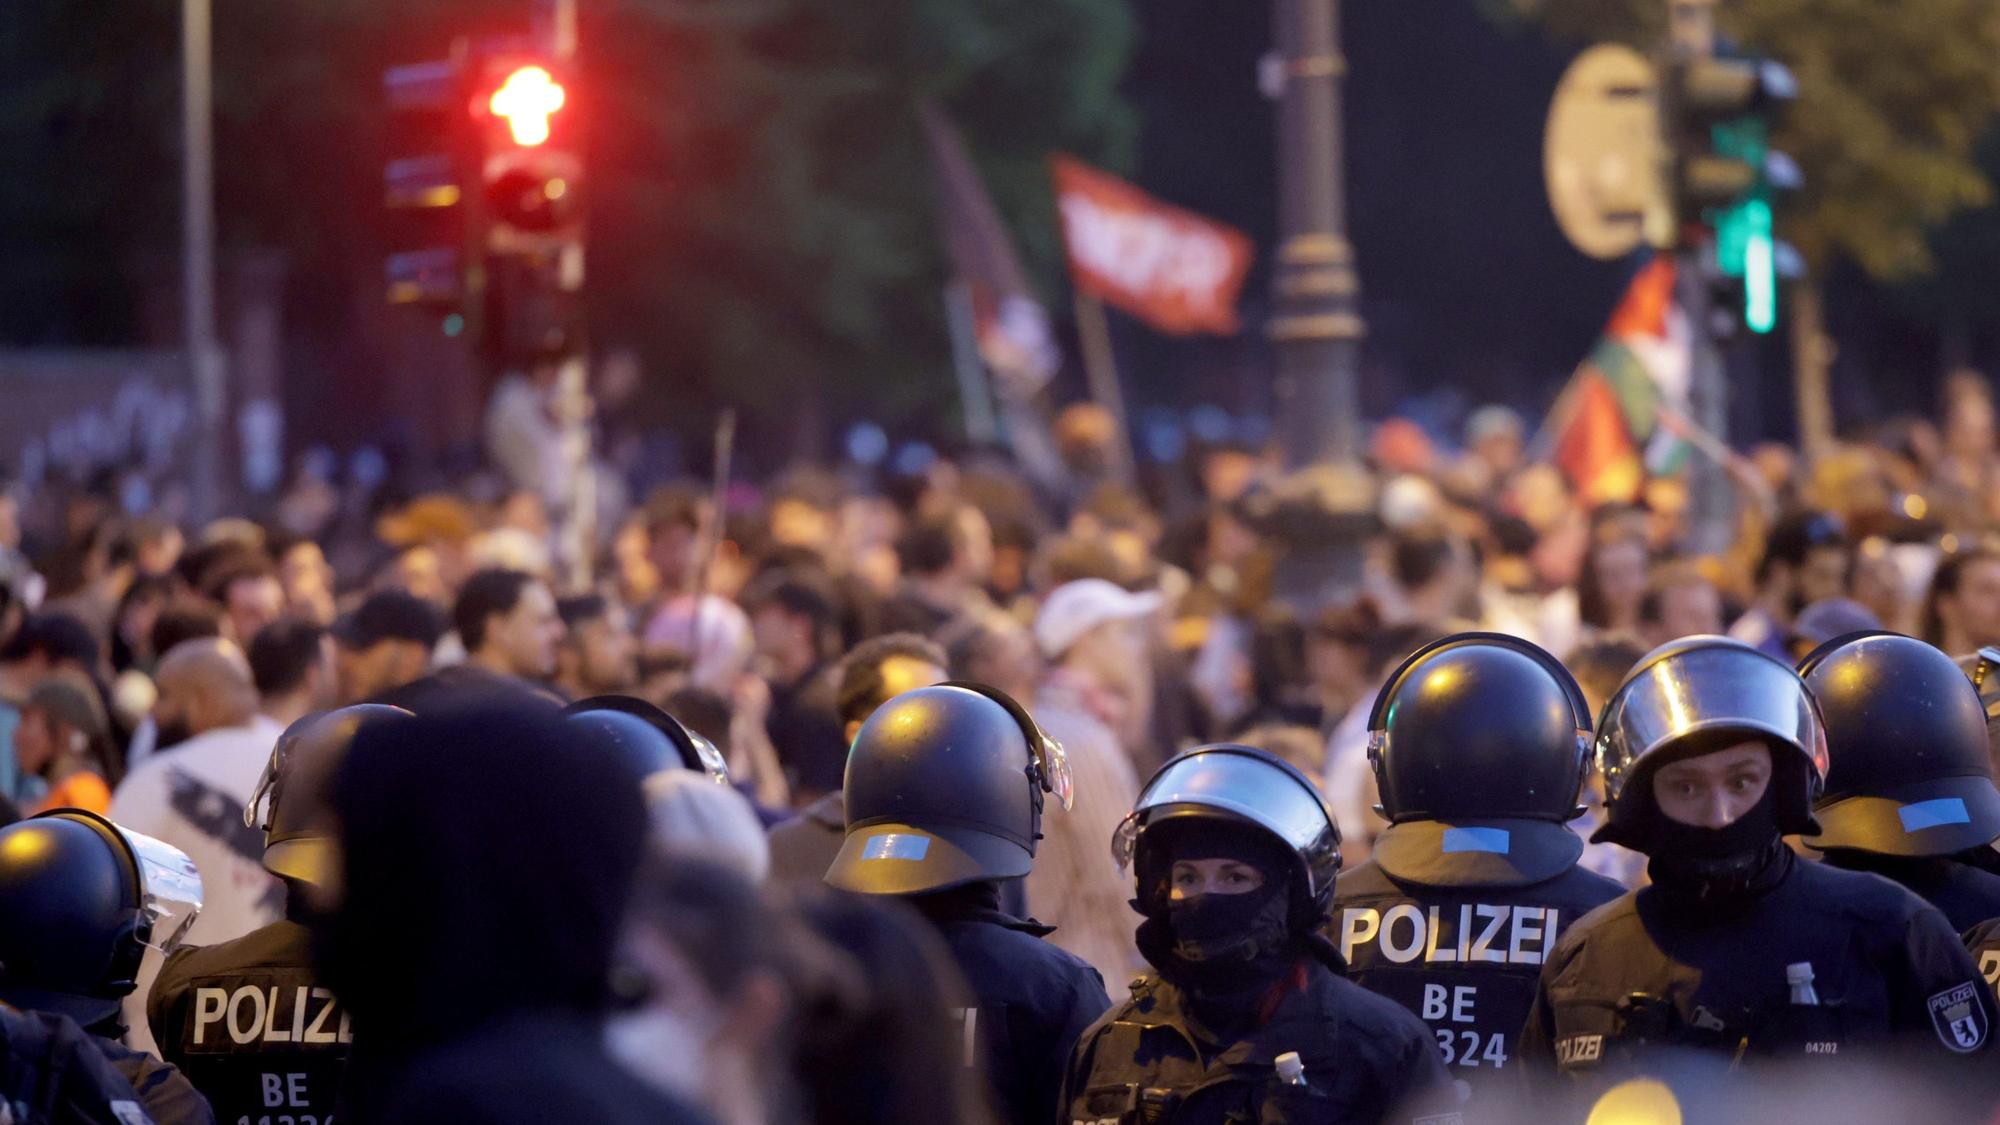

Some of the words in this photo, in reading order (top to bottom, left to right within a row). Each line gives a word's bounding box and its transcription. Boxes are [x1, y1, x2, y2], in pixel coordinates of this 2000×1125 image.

[1340, 903, 1559, 966] POLIZEI
[1422, 983, 1477, 1023] BE
[1931, 986, 1974, 1011] POLIZEI
[1805, 1042, 1838, 1054] 04202
[261, 1072, 310, 1108] BE
